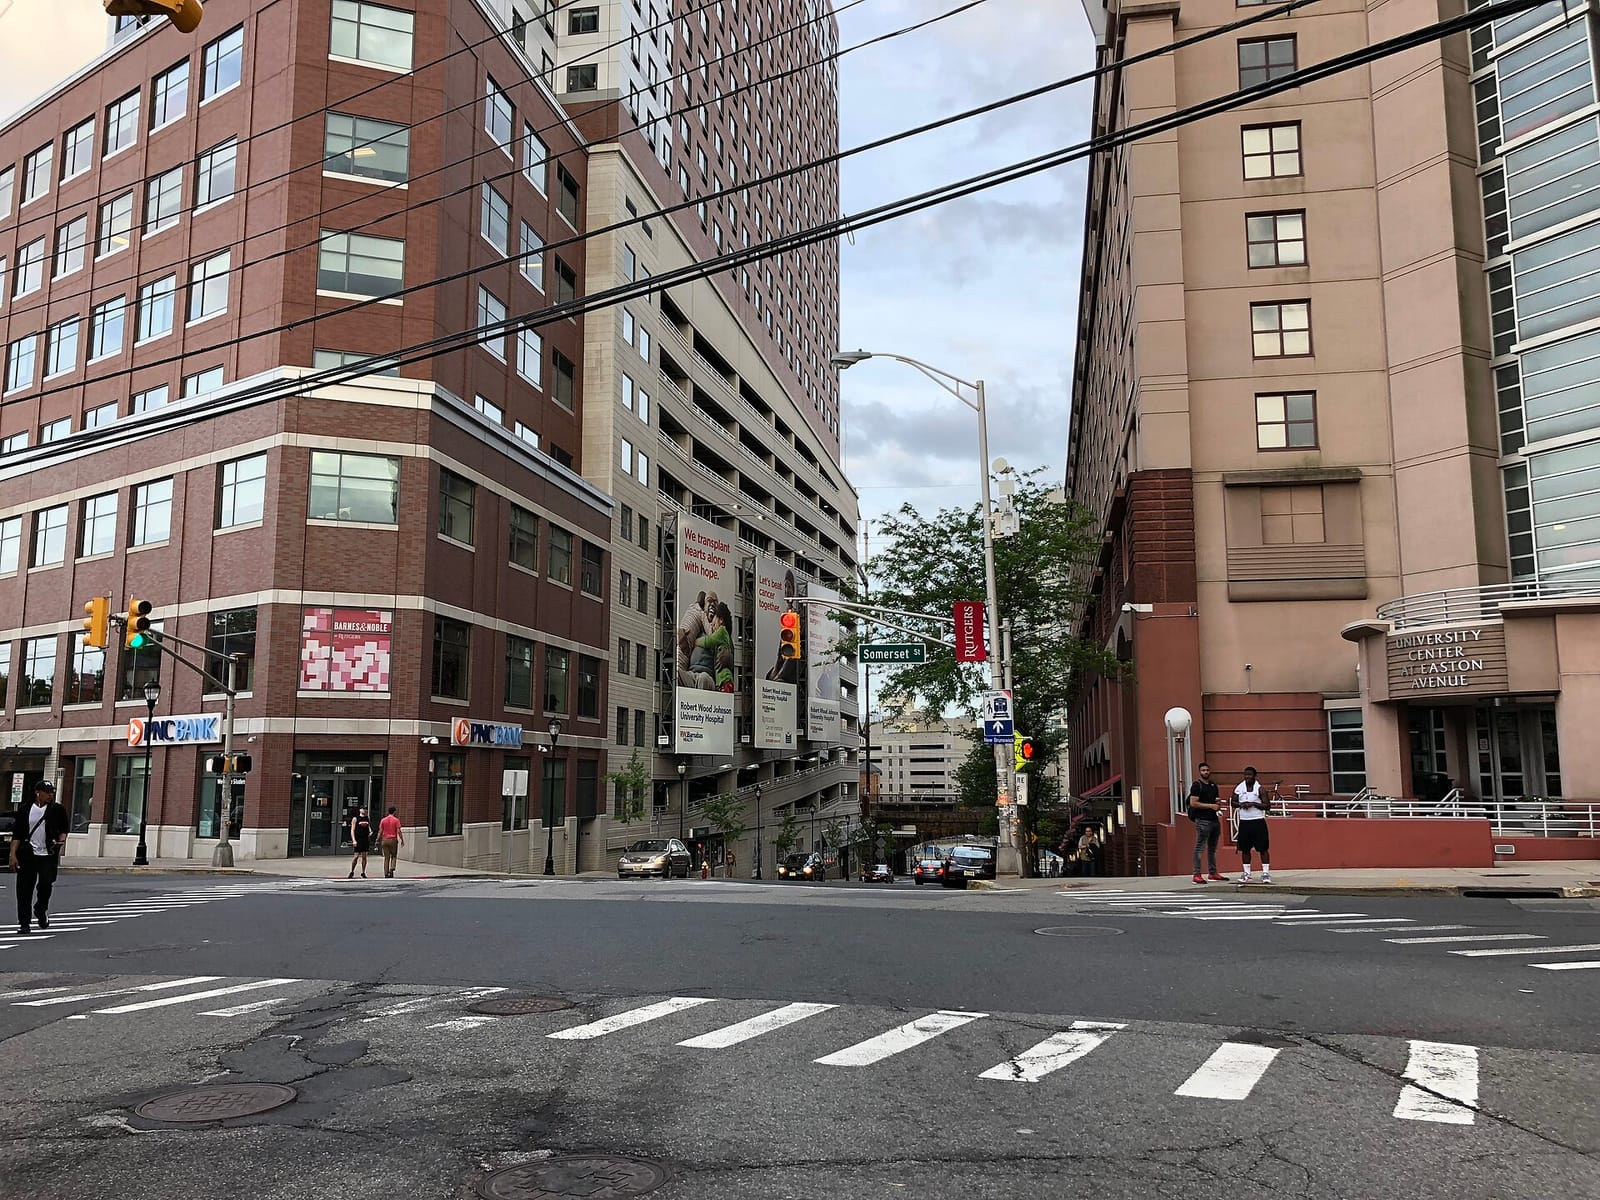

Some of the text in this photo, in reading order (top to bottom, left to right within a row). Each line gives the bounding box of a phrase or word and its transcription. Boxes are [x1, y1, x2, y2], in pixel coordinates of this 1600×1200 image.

[684, 528, 730, 553] We transplant
[685, 543, 726, 568] hearts along
[684, 561, 720, 580] with hope.
[759, 575, 783, 590] Let's beat
[759, 588, 775, 599] cancer
[963, 604, 976, 658] RUTGERS
[1396, 629, 1482, 649] UNIVERSITY
[863, 647, 921, 660] Somerset St
[1408, 645, 1465, 661] CENTER
[1400, 659, 1483, 676] AT EASTON
[1411, 674, 1469, 689] AVENUE
[680, 701, 732, 715] Robert Wood Johnson
[680, 712, 725, 725] University Hospital
